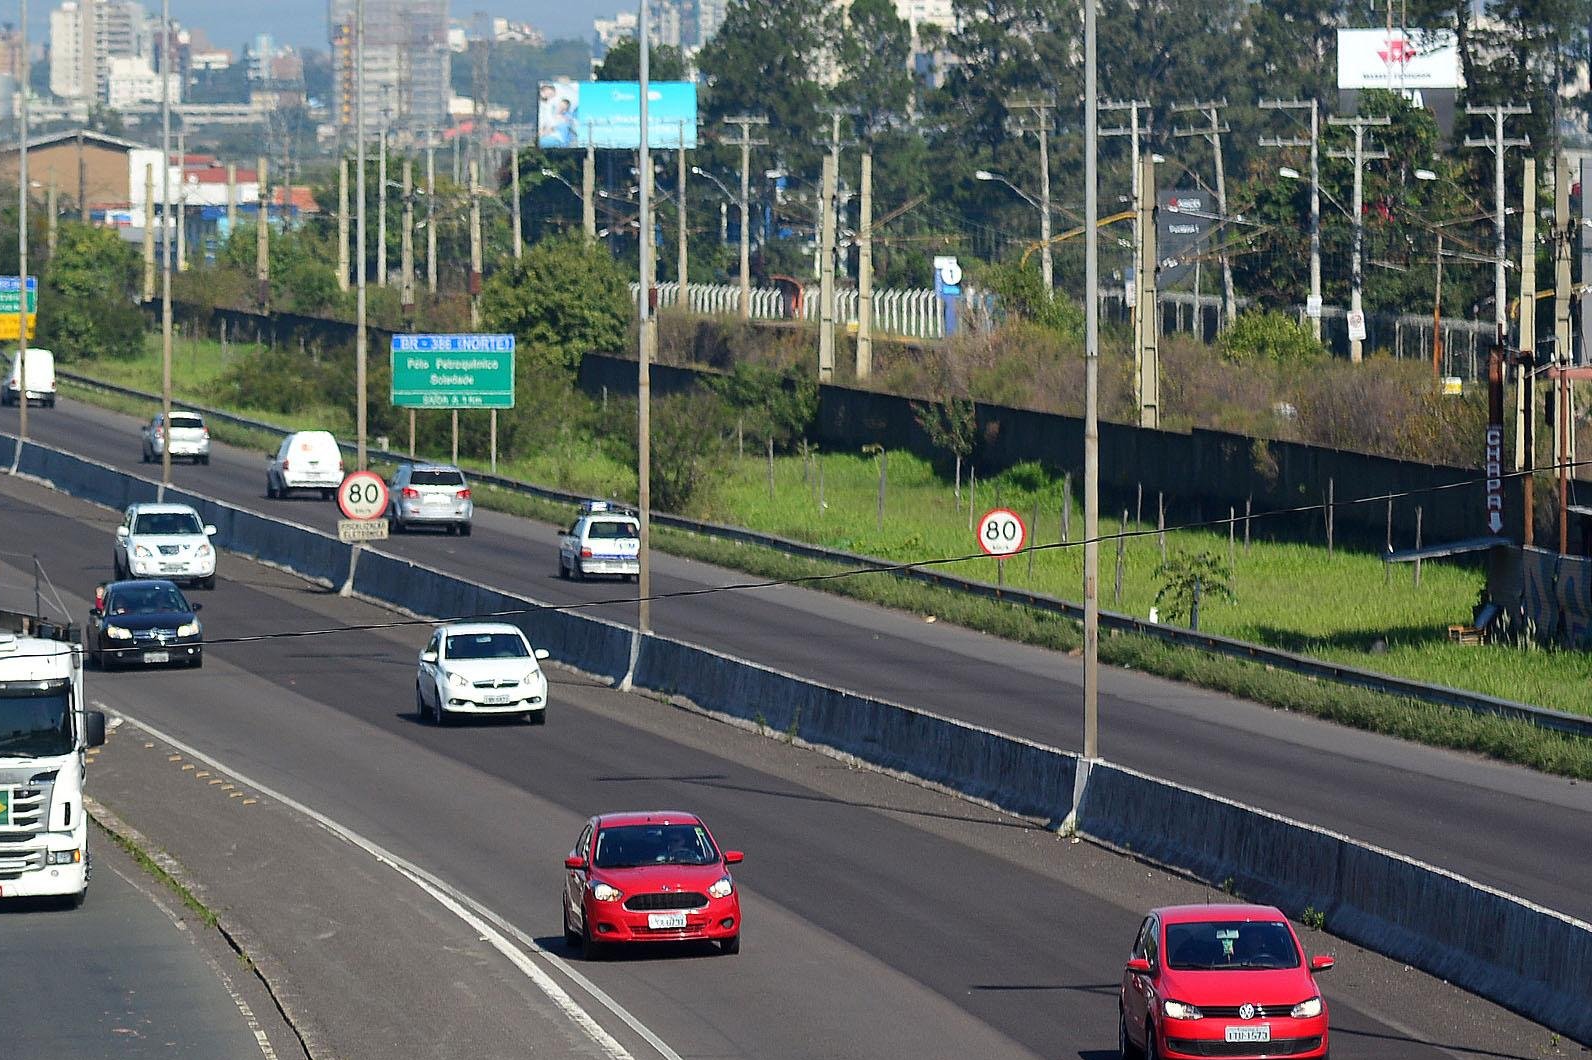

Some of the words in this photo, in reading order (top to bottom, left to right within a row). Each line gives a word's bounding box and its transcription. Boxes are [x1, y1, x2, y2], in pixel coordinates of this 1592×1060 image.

[402, 336, 418, 349] BR
[350, 484, 378, 503] 80
[986, 521, 1016, 540] 80
